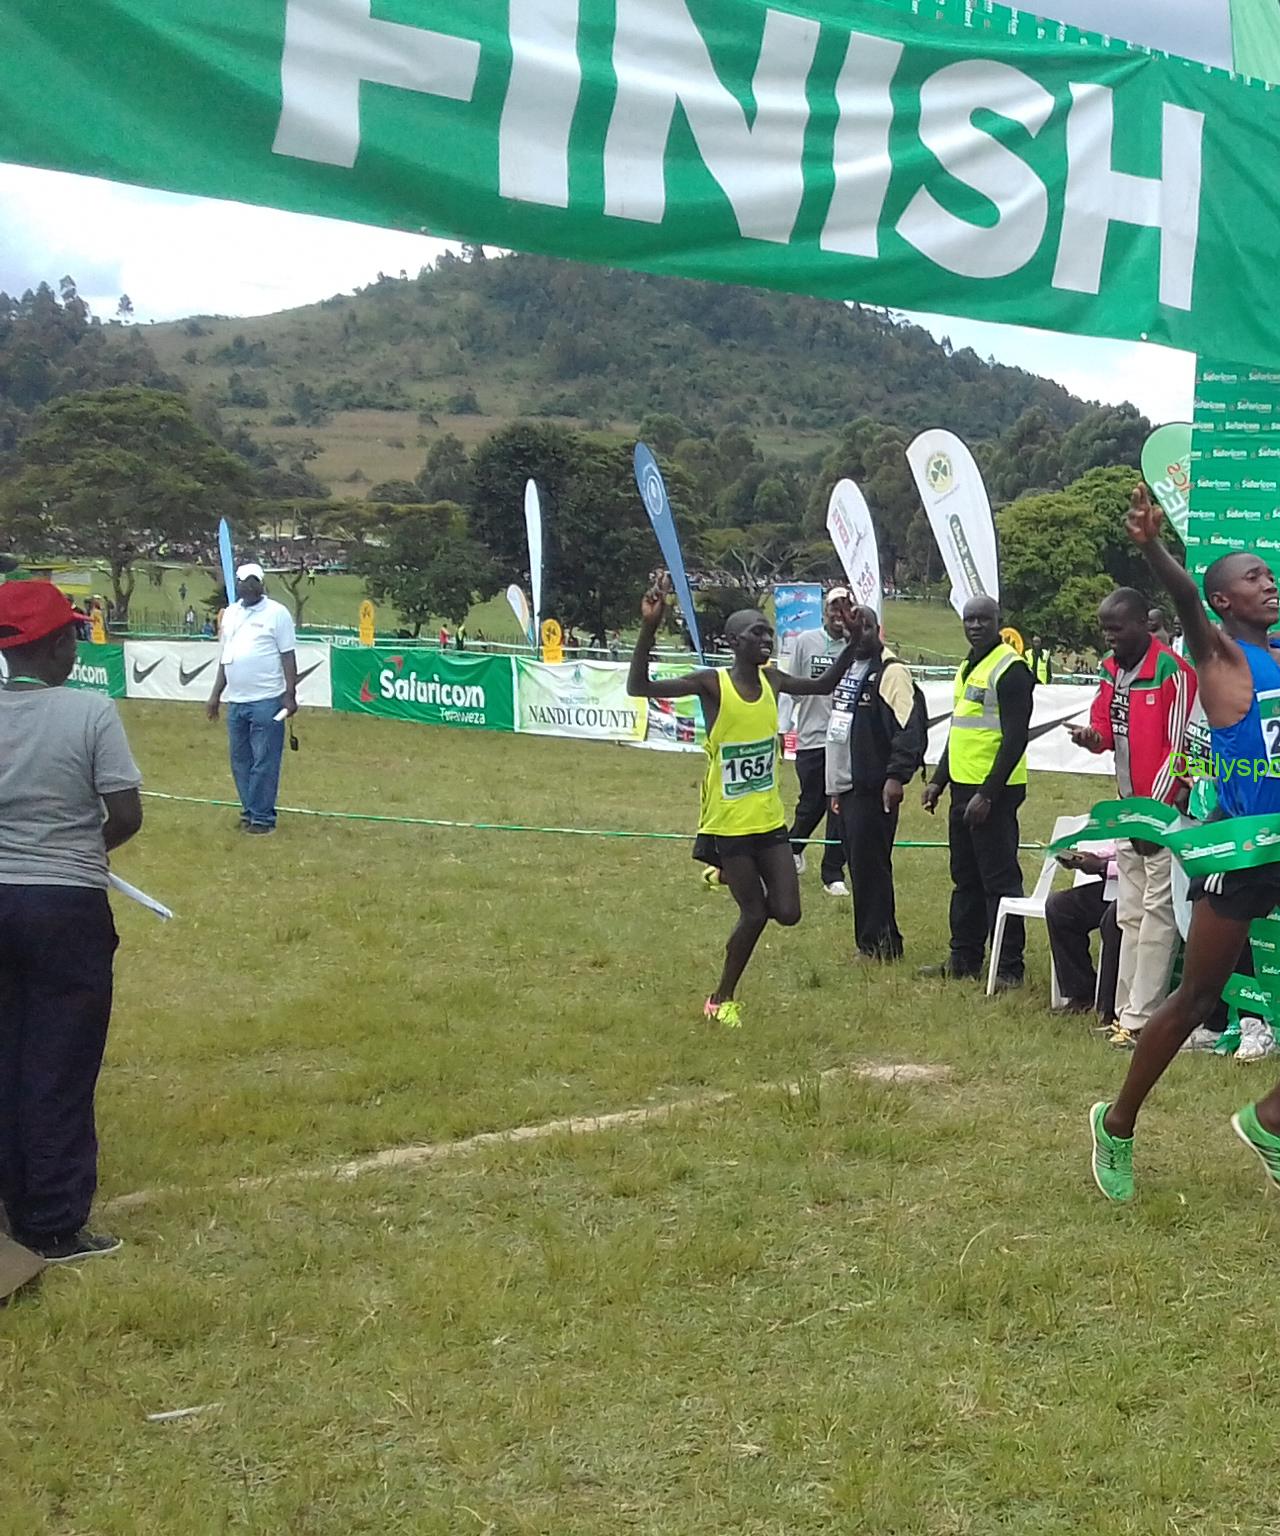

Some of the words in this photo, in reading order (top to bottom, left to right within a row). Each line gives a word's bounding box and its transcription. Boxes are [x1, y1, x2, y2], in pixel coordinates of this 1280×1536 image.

[272, 0, 1204, 311] FINISH
[379, 669, 485, 708] Safaricom
[528, 705, 572, 726] NANDI
[575, 708, 639, 729] COUNTY
